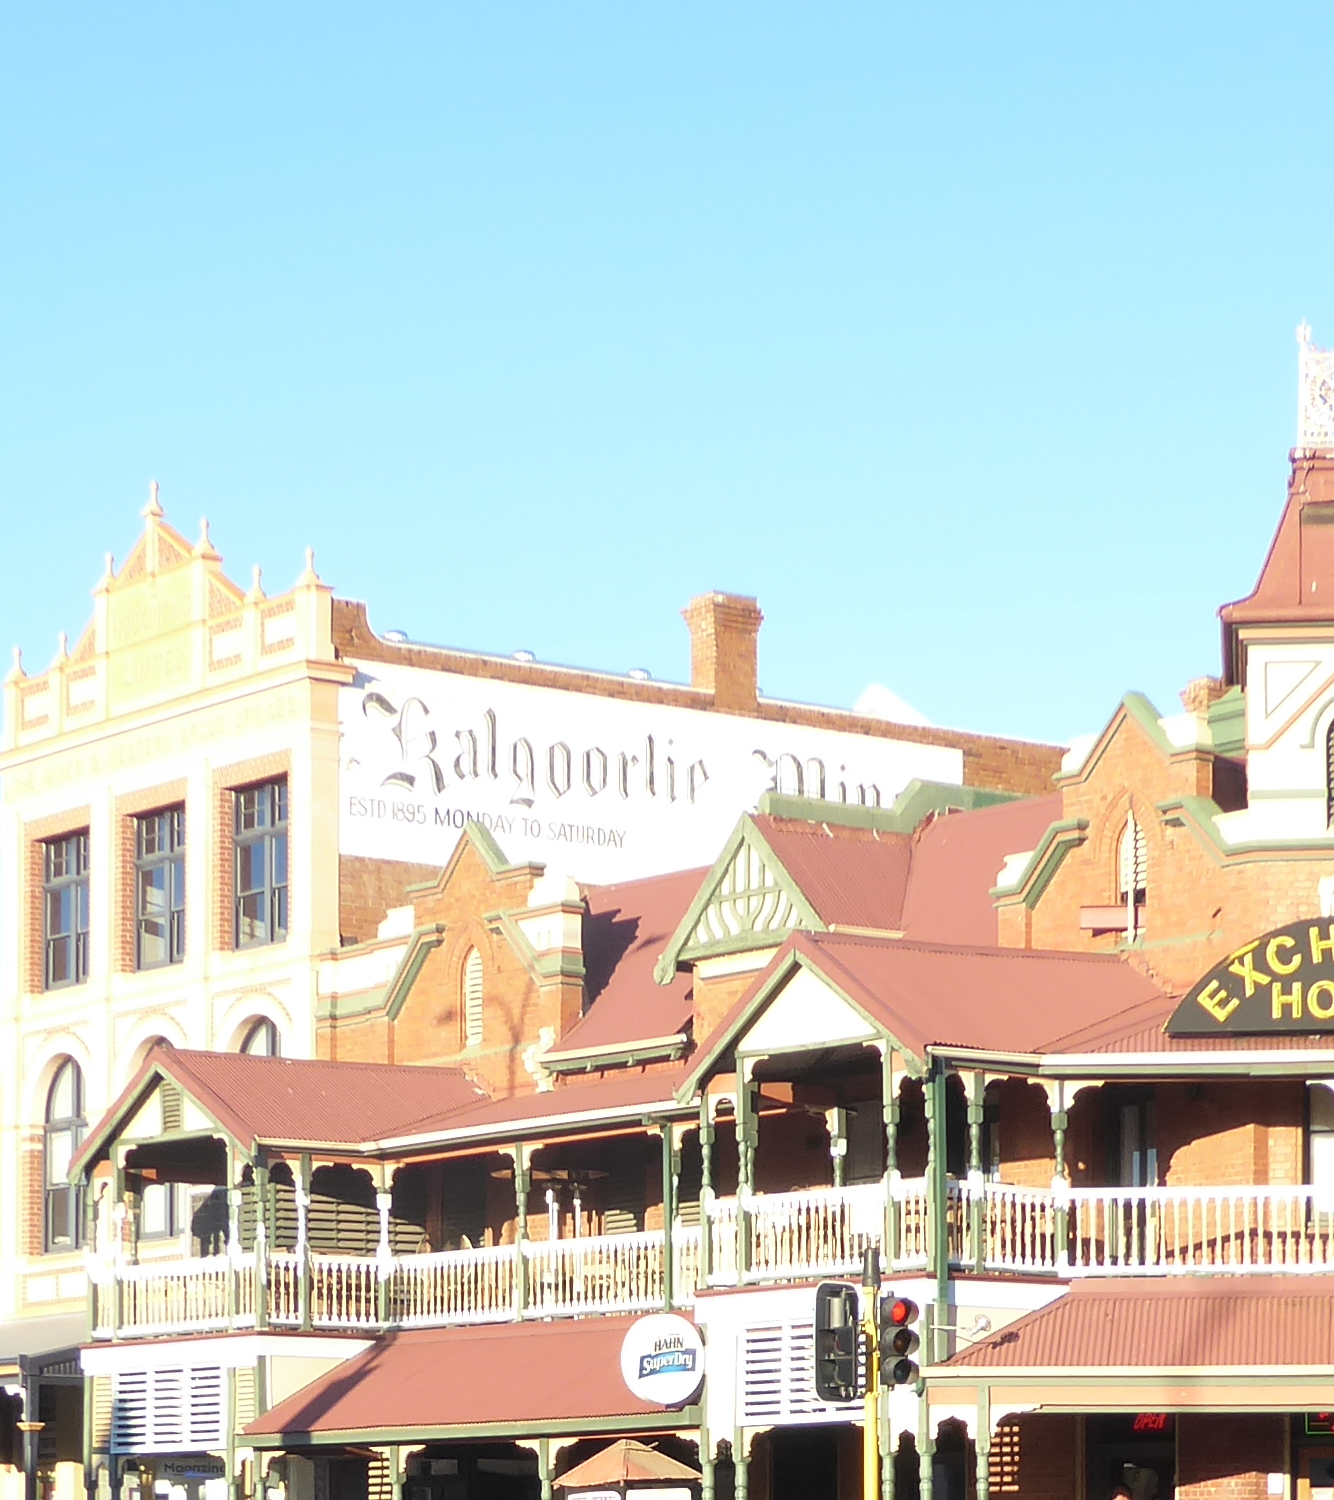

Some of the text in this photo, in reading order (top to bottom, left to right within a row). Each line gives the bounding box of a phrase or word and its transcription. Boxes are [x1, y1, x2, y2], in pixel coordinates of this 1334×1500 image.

[361, 691, 710, 808] Kalgoorlie
[349, 796, 387, 819] ESTD
[392, 801, 427, 825] 1895
[522, 817, 542, 839] TO
[547, 821, 627, 849] SATURDAY
[654, 1336, 684, 1353] HAHN
[641, 1351, 693, 1375] SuperDry
[1133, 1412, 1166, 1429] OPEN
